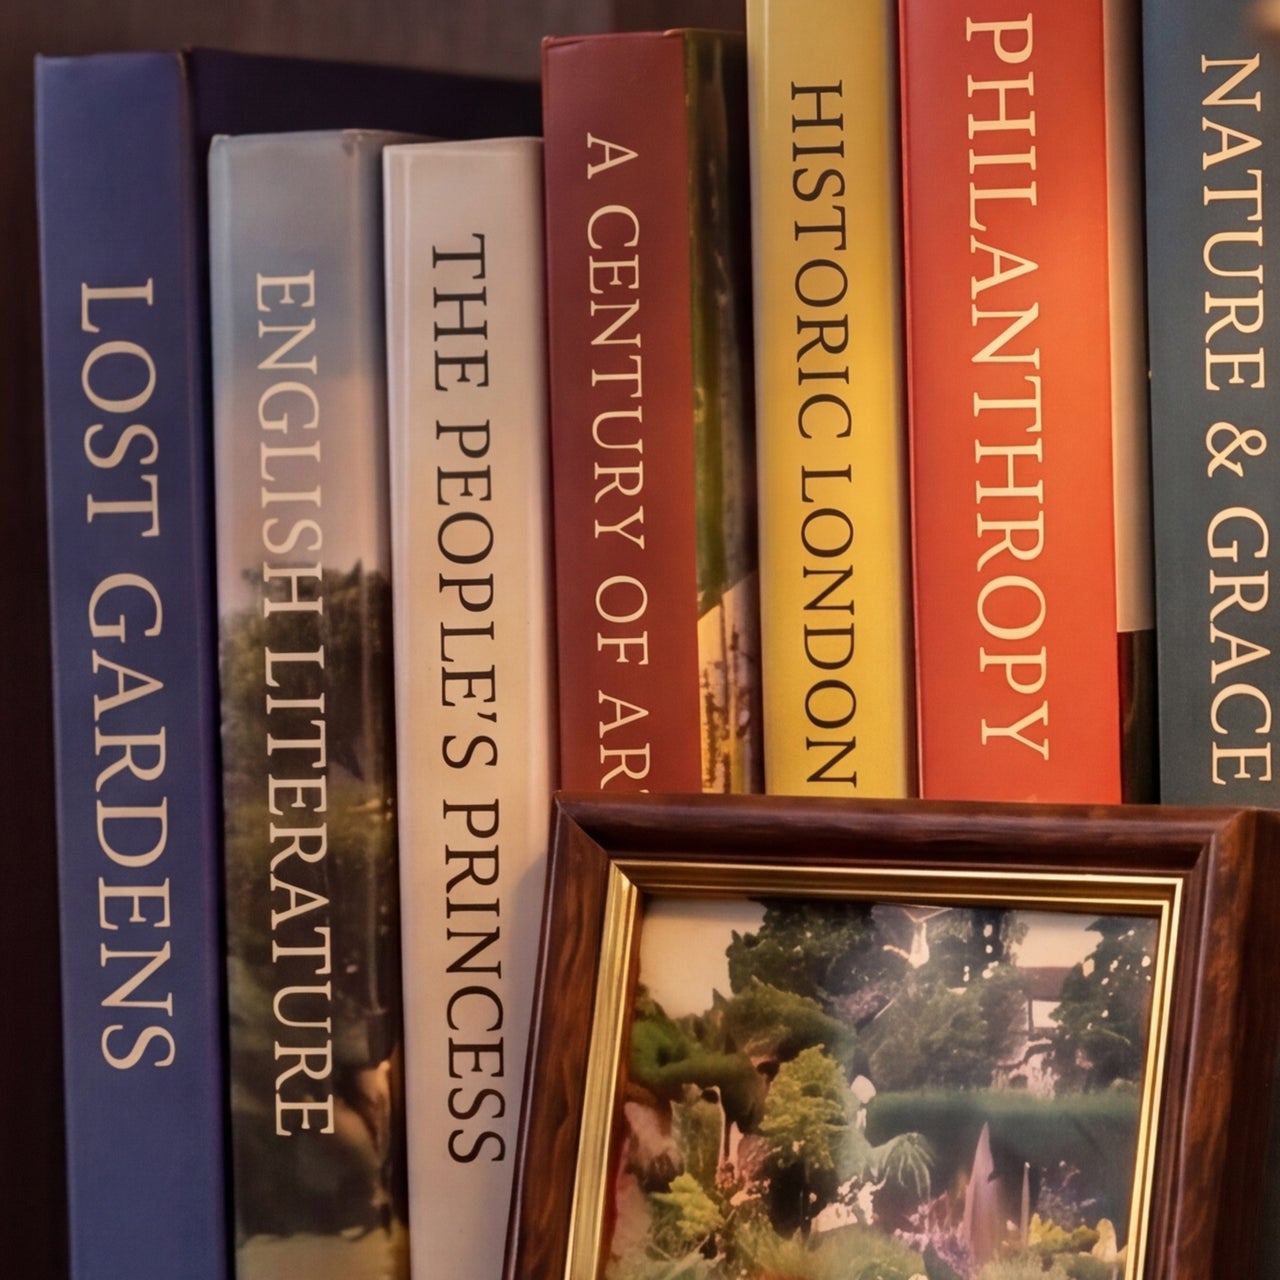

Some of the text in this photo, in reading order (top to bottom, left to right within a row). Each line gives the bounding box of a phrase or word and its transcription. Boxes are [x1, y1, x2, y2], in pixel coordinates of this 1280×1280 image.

[80, 277, 177, 1071] LOST GARDENS
[255, 268, 336, 1138] ENGLISH LITERATURE
[431, 232, 507, 1165] THE PEOPLE’S PRINCESS
[585, 131, 652, 794] A CENTURY OF AR
[789, 79, 858, 789] HISTORIC LONDON
[965, 12, 1051, 762] PHILANTHROPY
[1200, 52, 1273, 786] NATURE & GRACE
